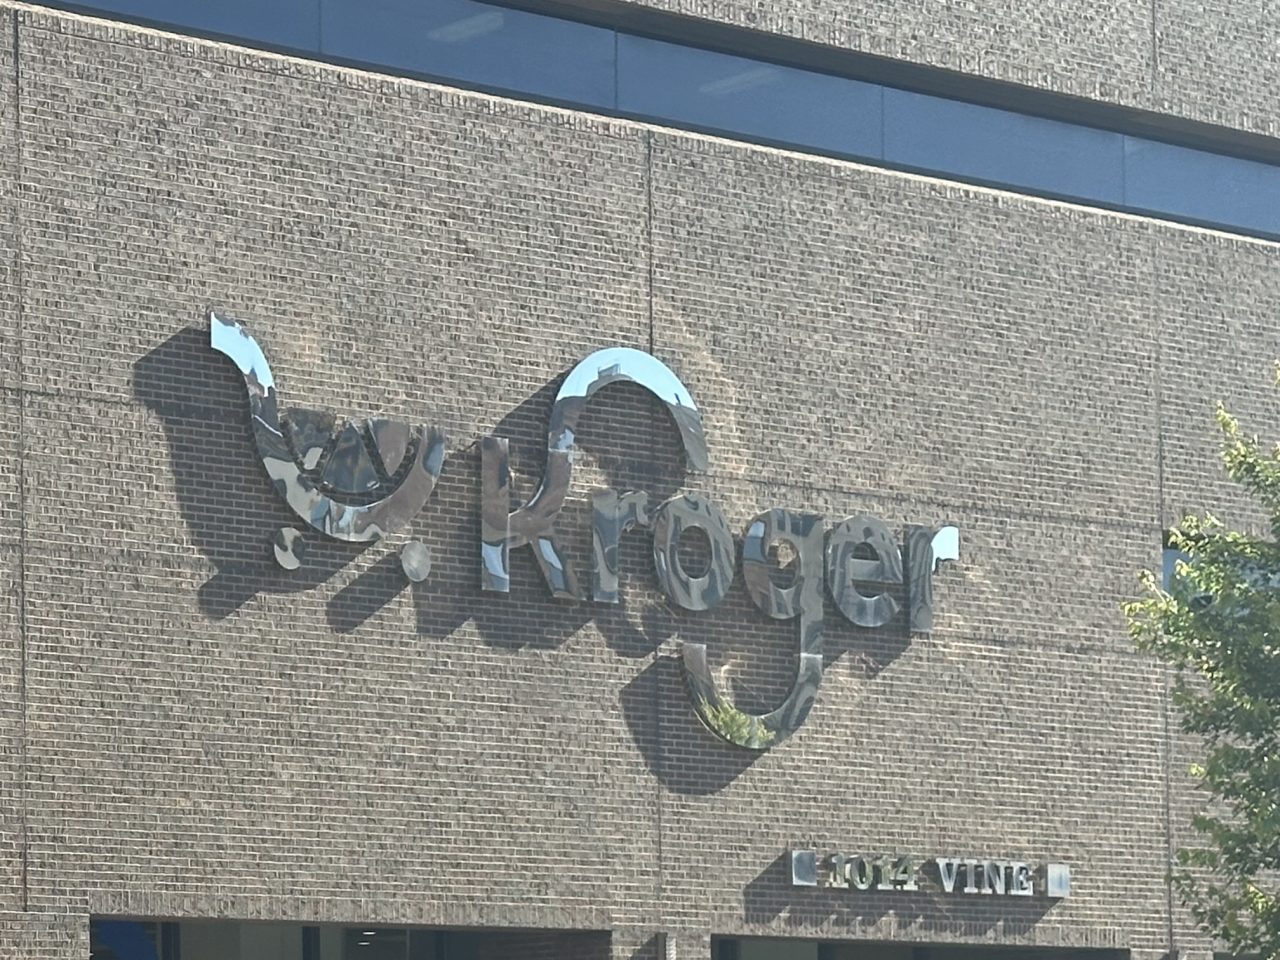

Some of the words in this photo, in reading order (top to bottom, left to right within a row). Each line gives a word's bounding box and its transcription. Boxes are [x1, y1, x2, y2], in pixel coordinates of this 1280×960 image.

[481, 346, 959, 749] Kroger
[827, 852, 919, 891] 1014
[935, 858, 1034, 896] VINE
